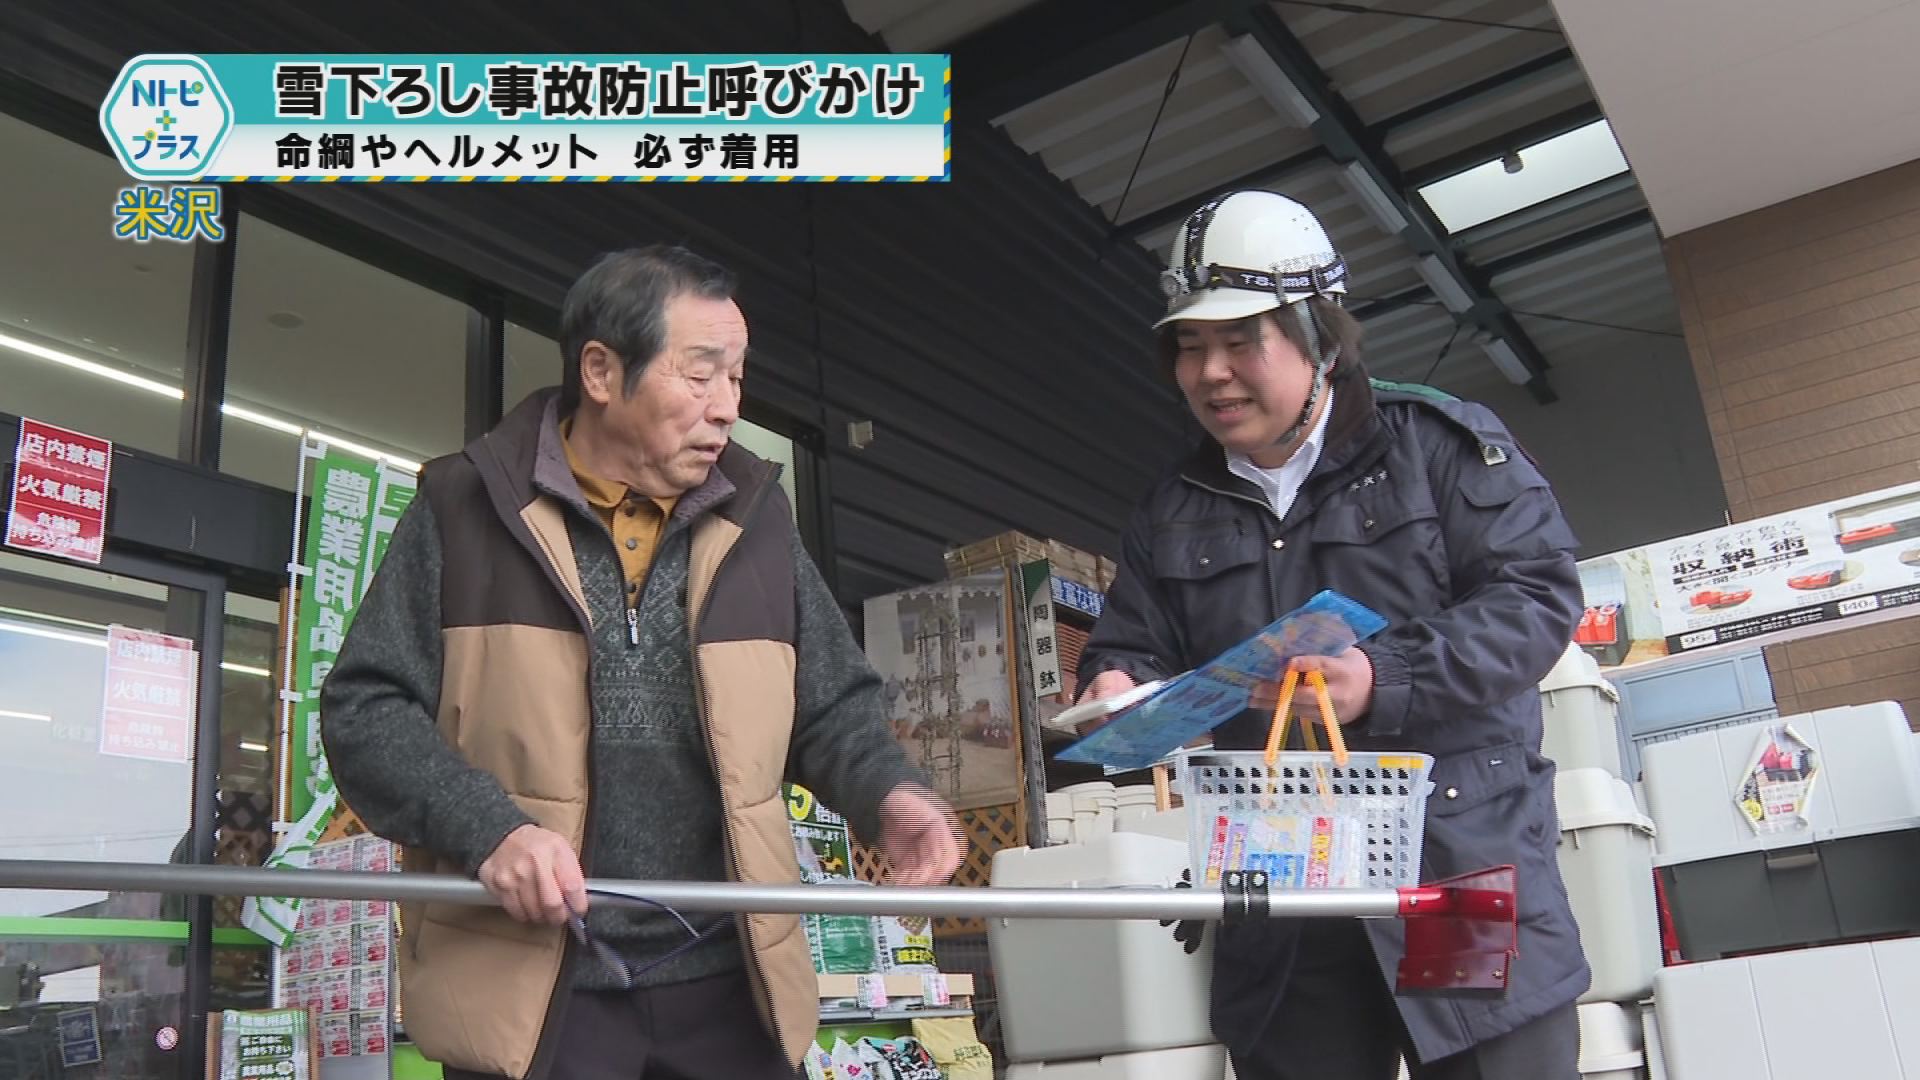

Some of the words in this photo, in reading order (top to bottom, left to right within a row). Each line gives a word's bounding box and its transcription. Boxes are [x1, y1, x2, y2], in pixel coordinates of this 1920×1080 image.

[24, 432, 107, 470] 店内禁煙
[19, 474, 102, 511] 火気厳禁
[1672, 535, 1806, 575] 収納術
